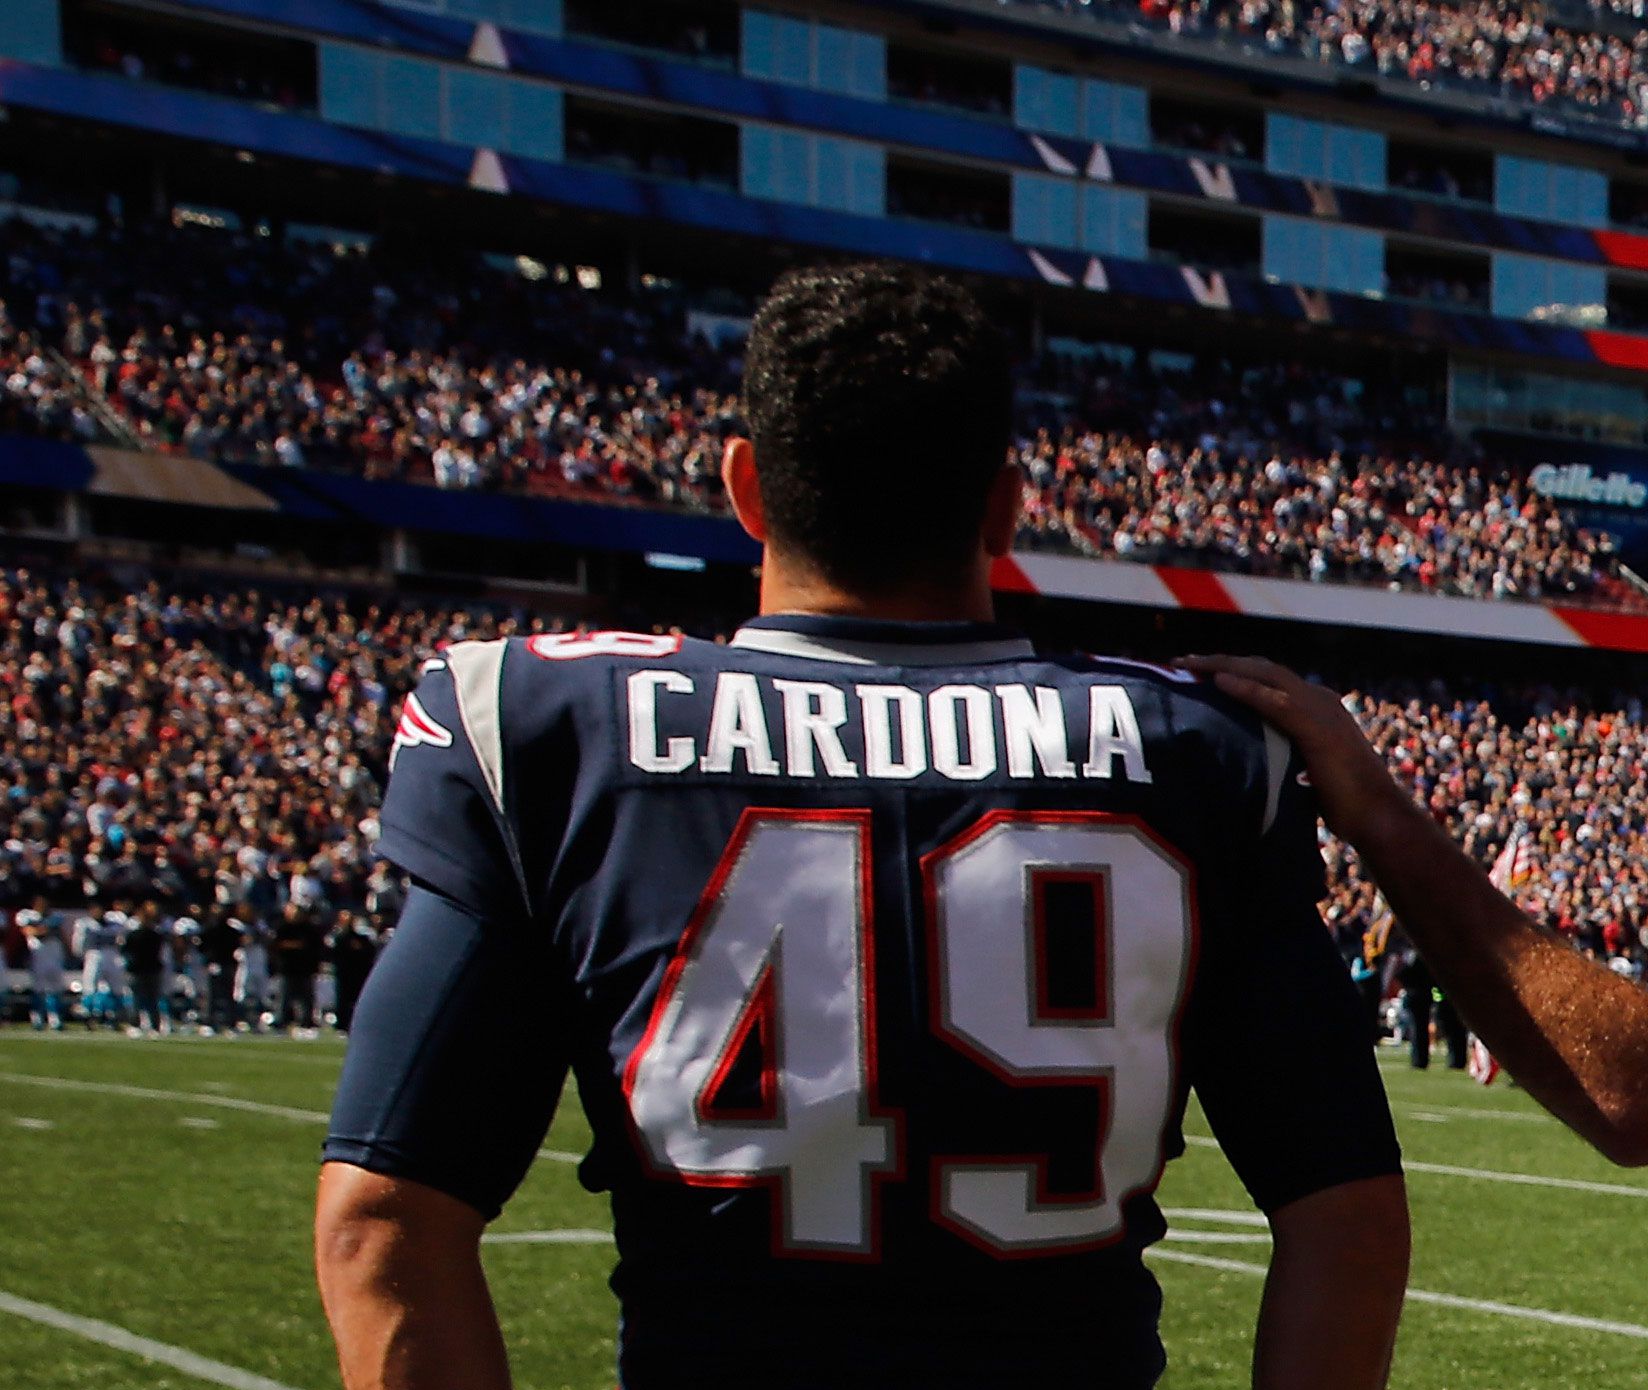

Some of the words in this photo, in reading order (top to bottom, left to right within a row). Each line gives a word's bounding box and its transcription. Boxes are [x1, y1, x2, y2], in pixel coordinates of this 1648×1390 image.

[1530, 463, 1648, 508] Gillette
[626, 669, 1153, 784] CARDONA
[622, 808, 1198, 1264] 49
